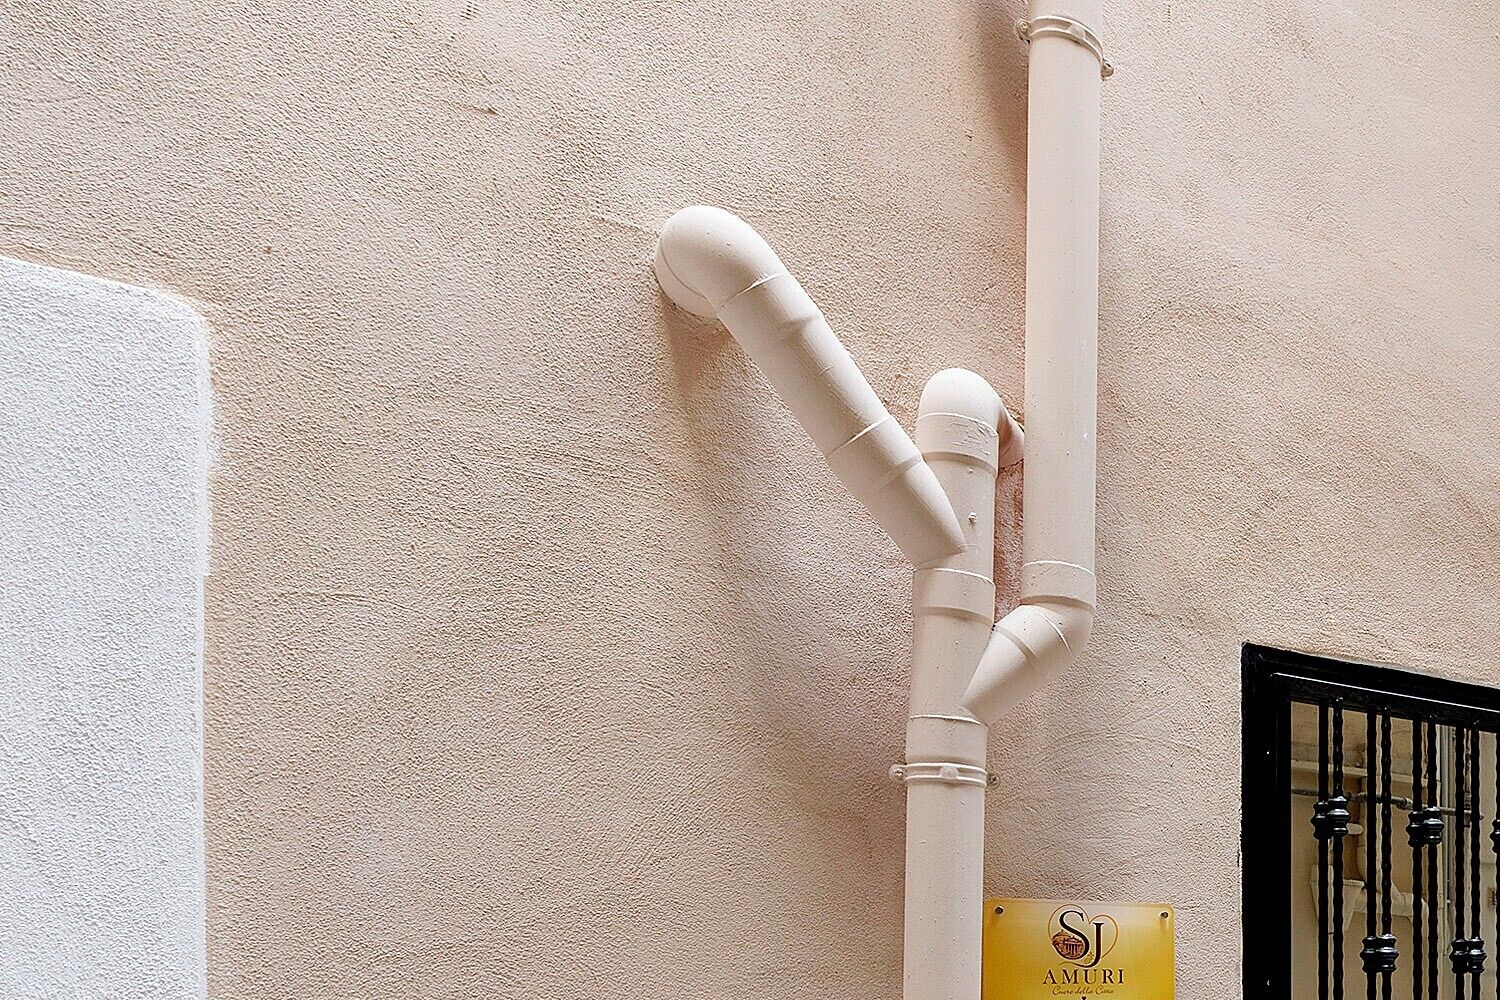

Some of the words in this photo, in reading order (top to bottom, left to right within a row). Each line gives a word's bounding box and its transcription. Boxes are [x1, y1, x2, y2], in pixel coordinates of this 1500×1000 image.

[1043, 969, 1124, 984] AMURI
[1052, 985, 1073, 996] Cuore
[1075, 986, 1093, 995] della
